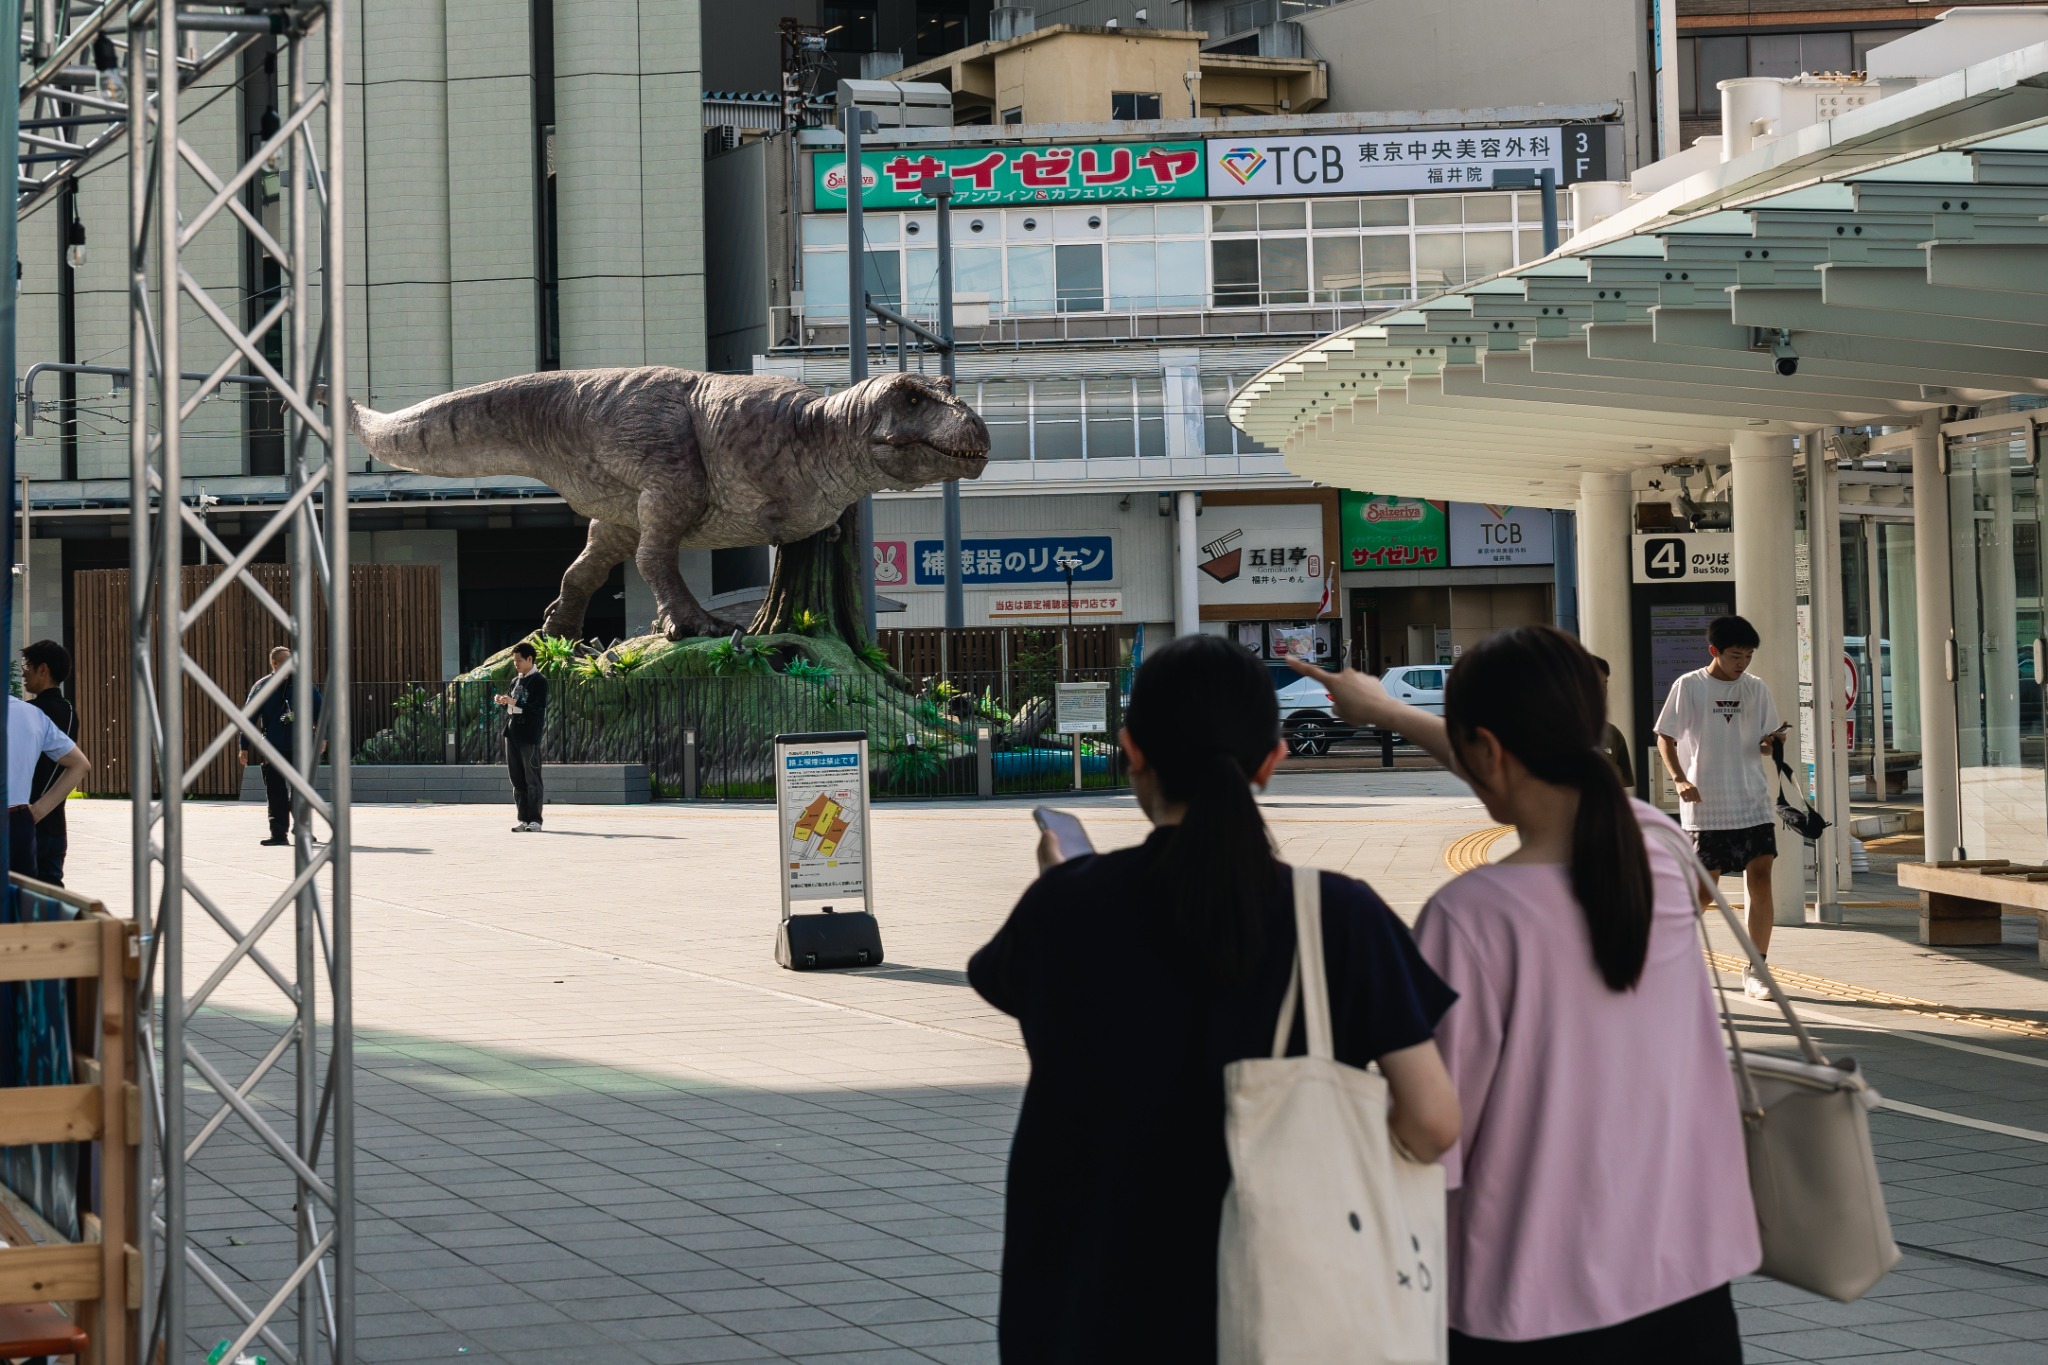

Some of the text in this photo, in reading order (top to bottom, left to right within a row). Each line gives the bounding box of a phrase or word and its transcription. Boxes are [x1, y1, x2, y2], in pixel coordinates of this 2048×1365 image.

[1358, 136, 1550, 162] 東京中央美容外科
[884, 147, 1199, 191] サイゼリヤ
[1266, 145, 1344, 185] TCB
[826, 172, 874, 189] Saiya
[1427, 167, 1483, 184] 福井院
[908, 185, 1176, 205] イアンワイン&カフェレストラン
[1480, 523, 1522, 545] TCB
[1248, 546, 1308, 566] 五目亭
[1351, 545, 1438, 567] サイゼリヤ
[1651, 542, 1680, 575] 4
[1691, 552, 1730, 566] のりば
[1251, 576, 1305, 584] 福井らーめん
[1693, 566, 1730, 575] Bus Stop
[995, 598, 1118, 611] 当店は認定補聴器専門店です
